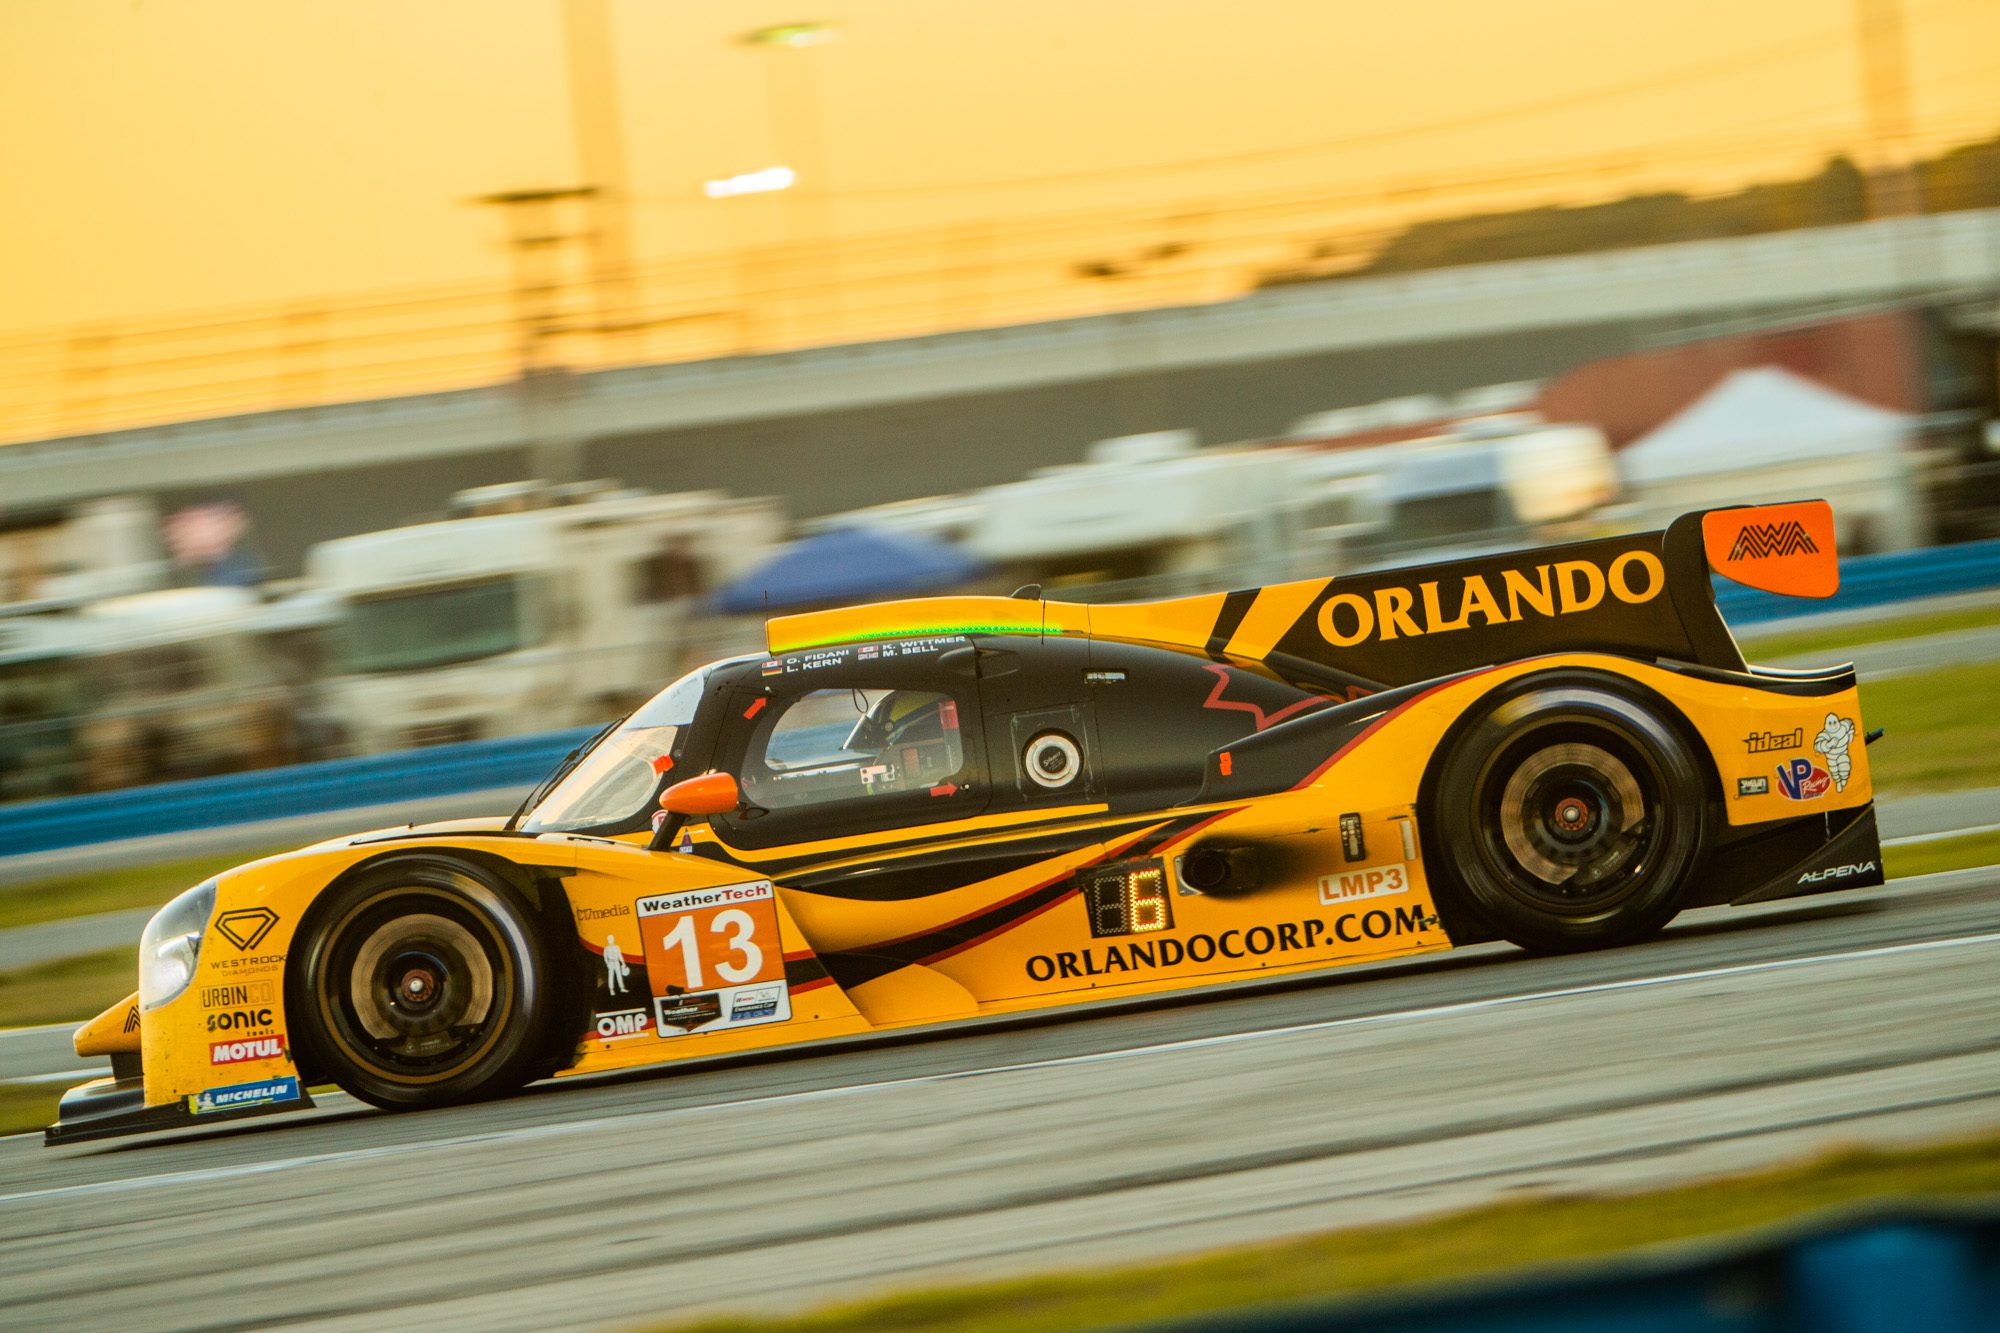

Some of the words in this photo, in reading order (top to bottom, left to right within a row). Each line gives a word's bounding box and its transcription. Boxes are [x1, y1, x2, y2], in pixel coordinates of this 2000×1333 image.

[1317, 550, 1665, 647] ORLANDO
[900, 636, 966, 648] WITTMER
[902, 645, 939, 654] BELL
[786, 665, 799, 673] L.
[802, 657, 842, 670] KERN
[804, 649, 849, 662] FIDANI
[1744, 728, 1803, 753] ideal
[1776, 758, 1812, 800] VP
[1321, 868, 1404, 900] LMP3
[1797, 861, 1876, 884] ALPENA
[643, 884, 768, 912] WeatherTech
[662, 908, 763, 989] 13
[1025, 904, 1428, 982] ORLANDOCORP.COM
[210, 954, 287, 969] WESTROCK
[222, 964, 278, 977] DIAMONDS
[246, 1029, 274, 1037] tools
[597, 1013, 648, 1036] OMP
[213, 1038, 282, 1062] MOTUL
[215, 1084, 288, 1104] MICHELIN
